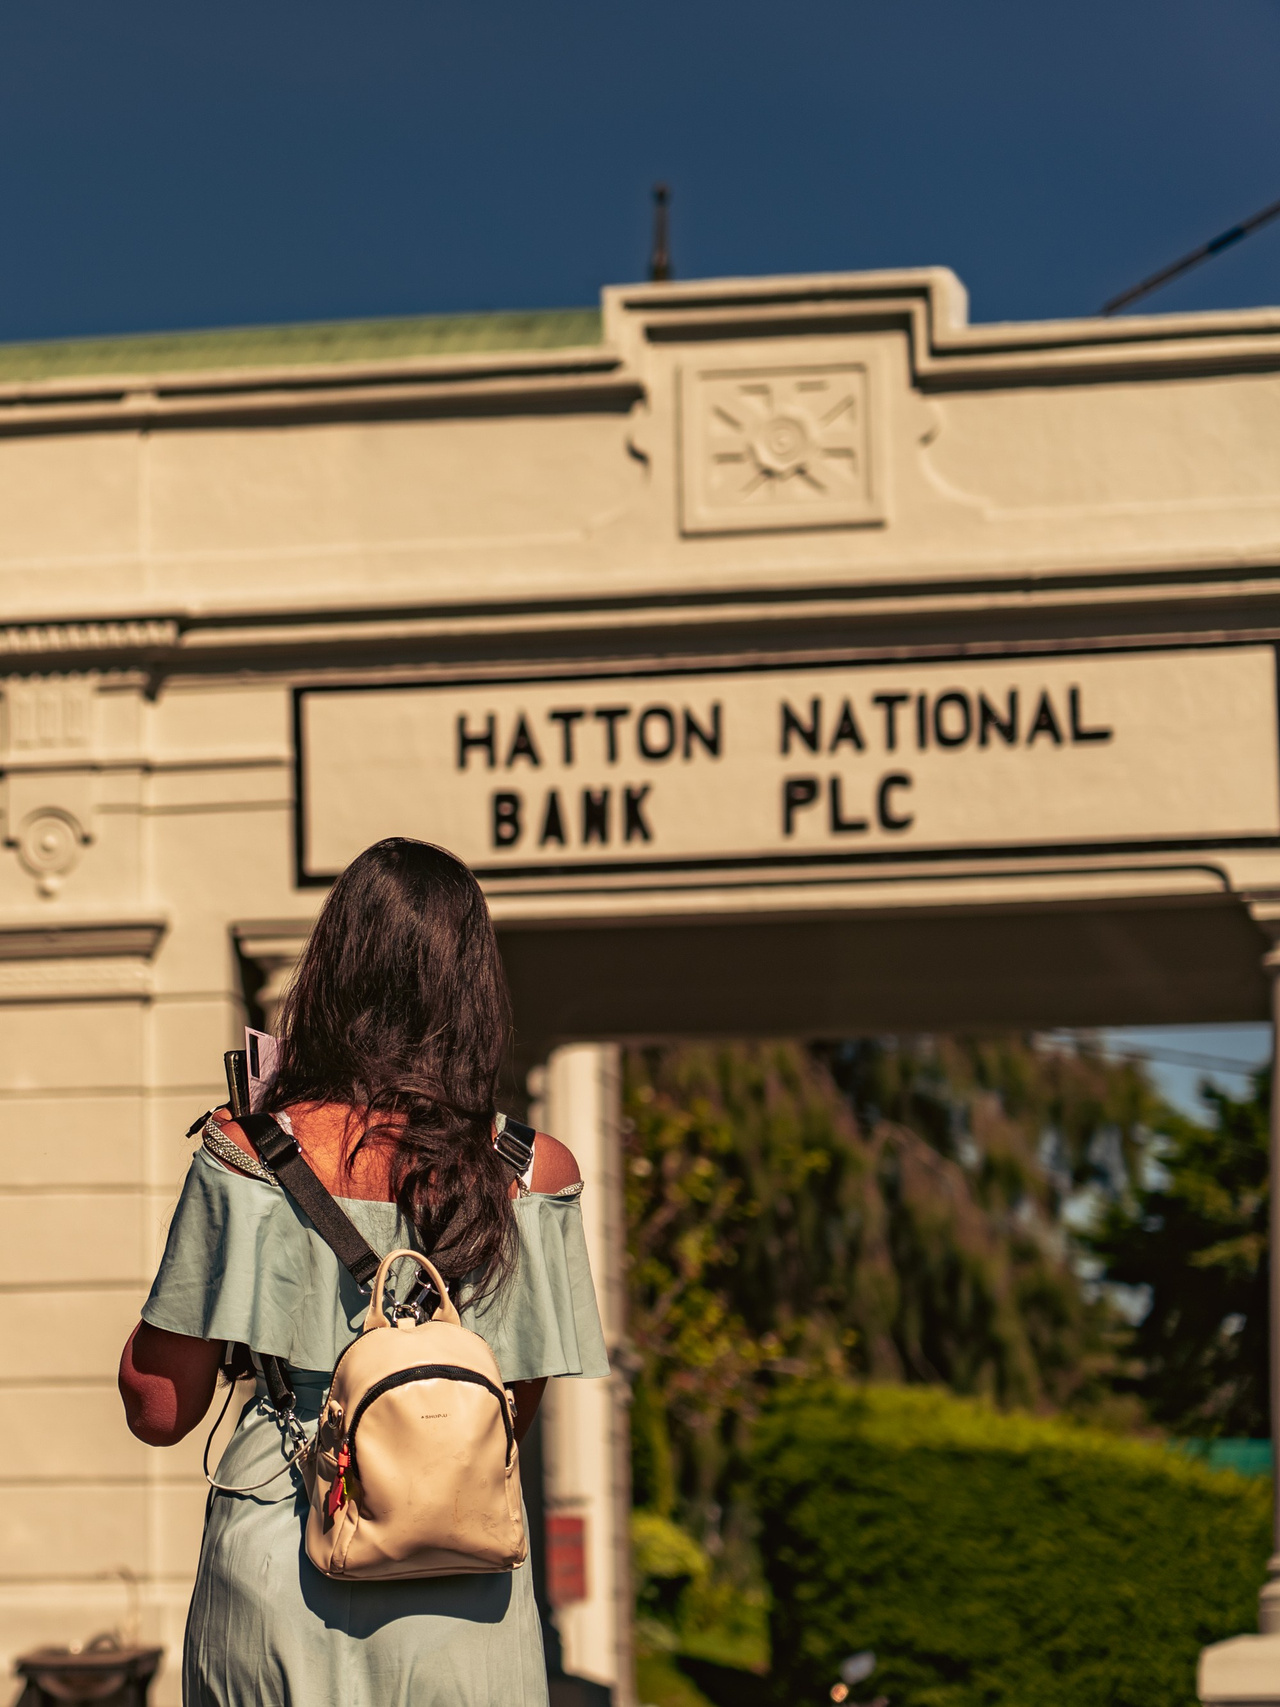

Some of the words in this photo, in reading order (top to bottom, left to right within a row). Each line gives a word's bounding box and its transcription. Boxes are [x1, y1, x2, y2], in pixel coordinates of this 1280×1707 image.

[454, 702, 723, 771] HATTON
[779, 685, 1114, 756] NATIONAL
[490, 783, 654, 850] BANK
[781, 772, 915, 838] PLC
